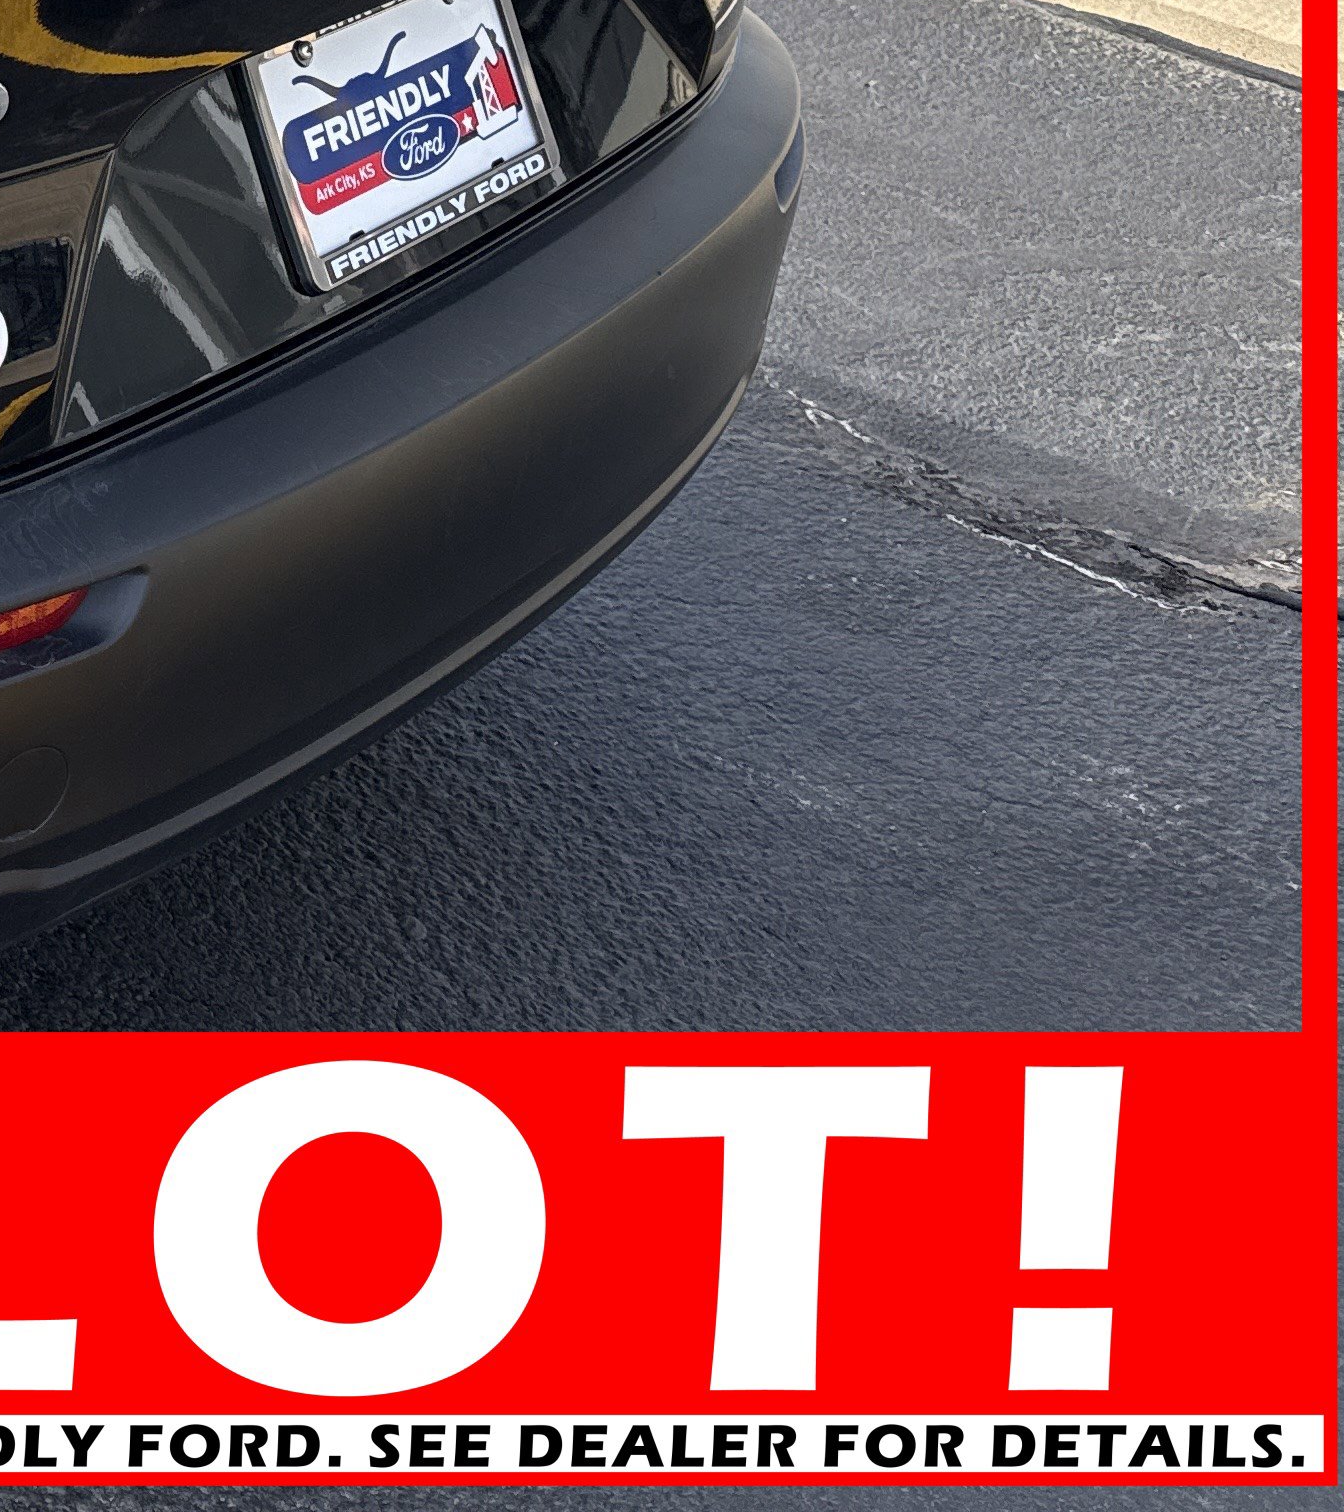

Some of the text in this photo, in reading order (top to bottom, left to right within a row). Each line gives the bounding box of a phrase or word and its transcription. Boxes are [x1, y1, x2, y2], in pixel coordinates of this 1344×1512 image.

[303, 64, 453, 162] FRIENDLY
[399, 122, 446, 171] Ford
[316, 162, 376, 204] Ark City, KS
[330, 153, 546, 279] FRIENDLY FORD
